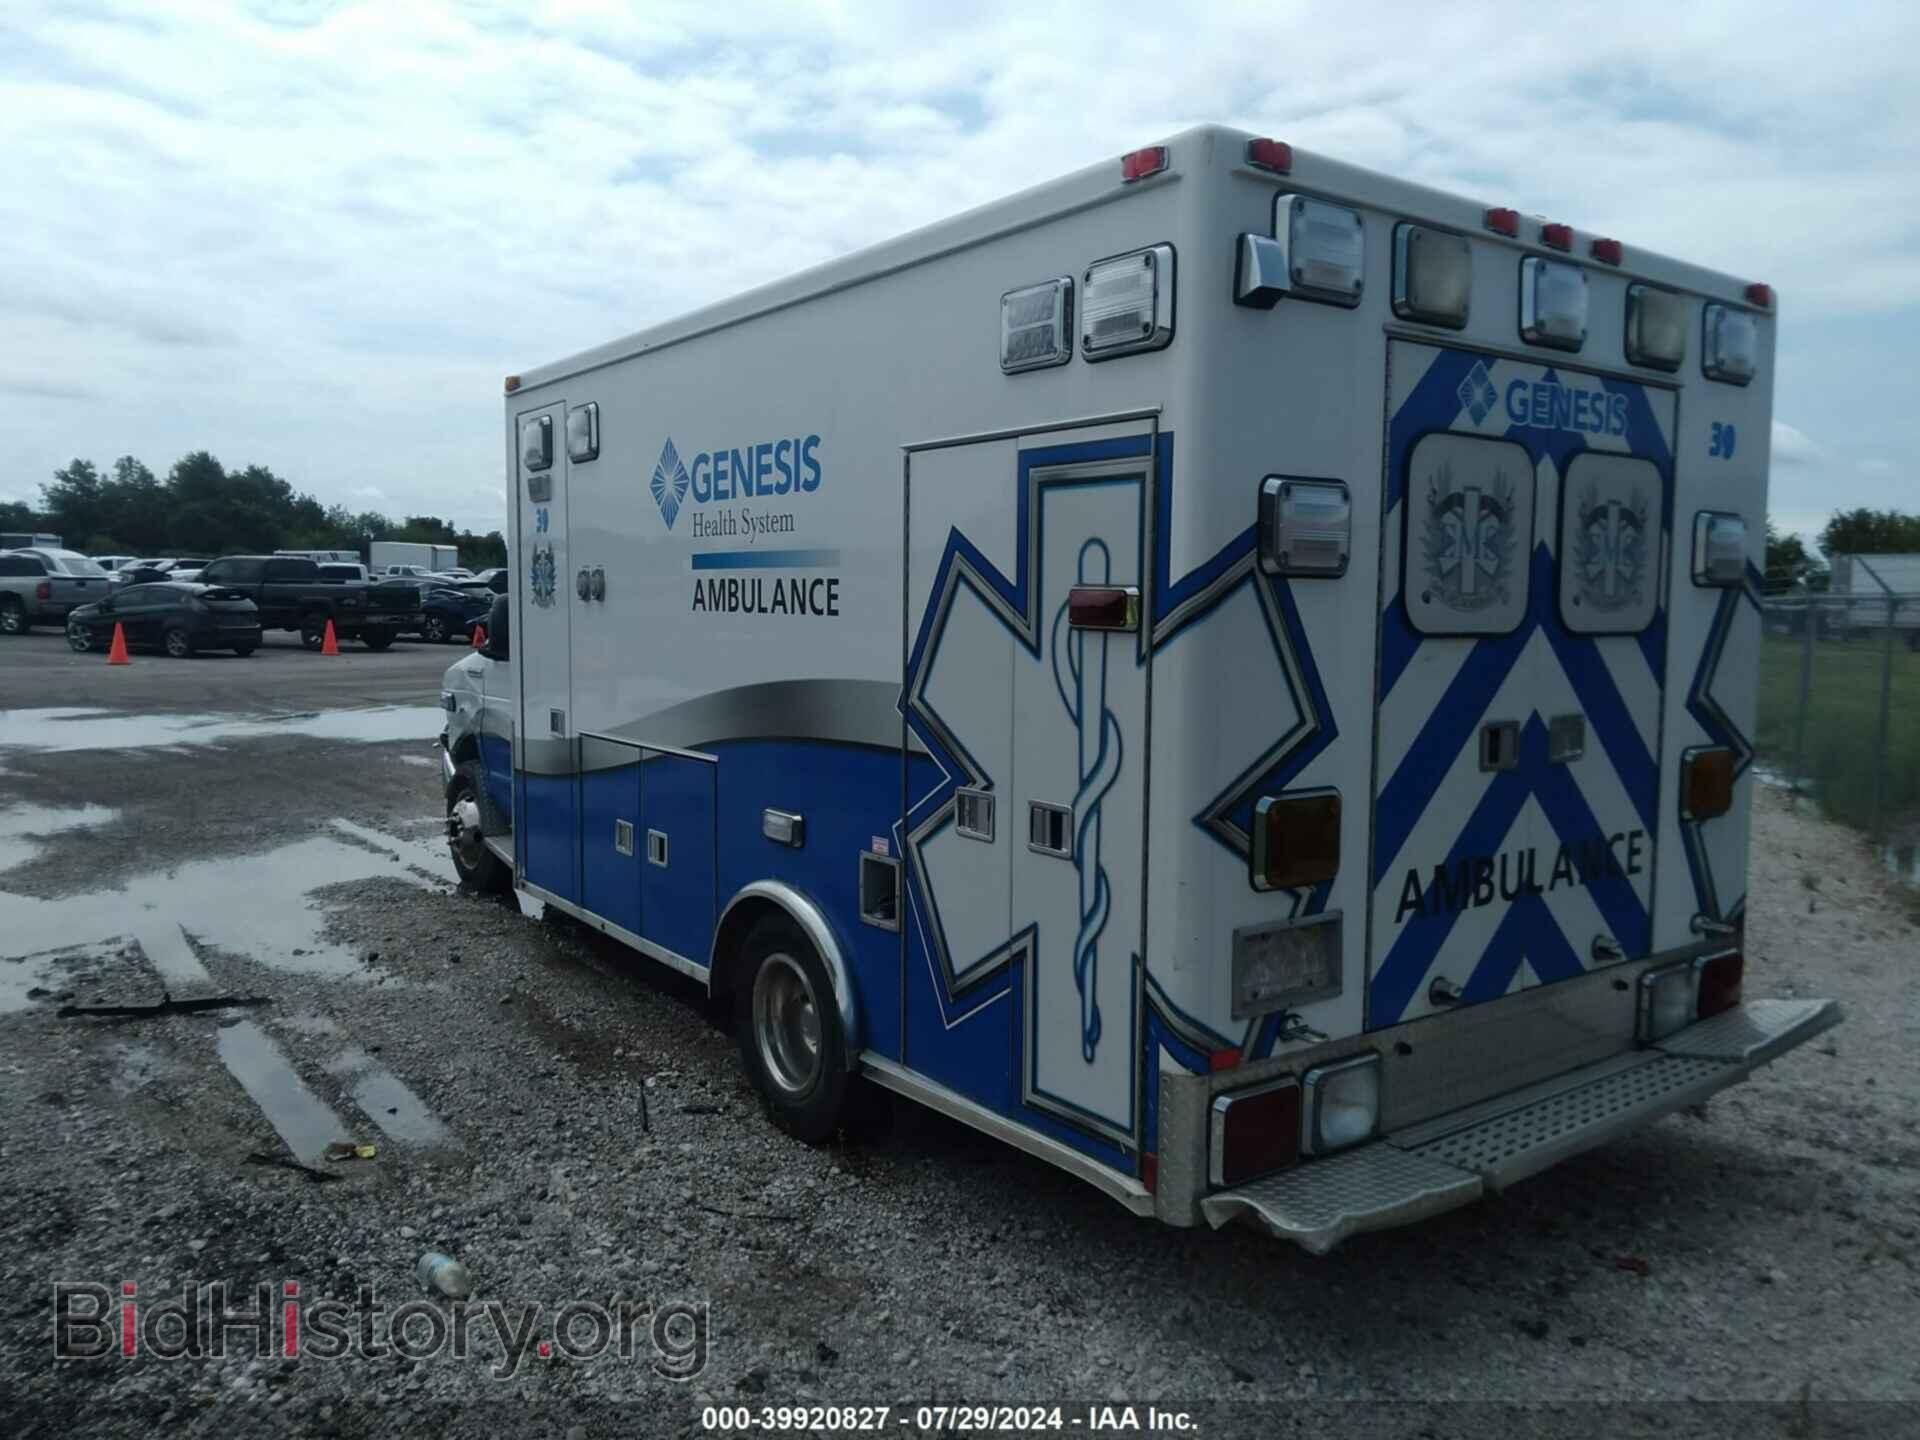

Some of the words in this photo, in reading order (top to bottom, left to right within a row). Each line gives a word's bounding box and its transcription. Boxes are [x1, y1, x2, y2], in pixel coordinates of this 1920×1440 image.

[1505, 379, 1629, 437] GENESIS
[691, 434, 822, 504] GENESIS
[693, 510, 737, 538] Health
[741, 508, 795, 544] System
[692, 578, 840, 616] AMBULANCE
[1395, 829, 1644, 924] AMBULANCE
